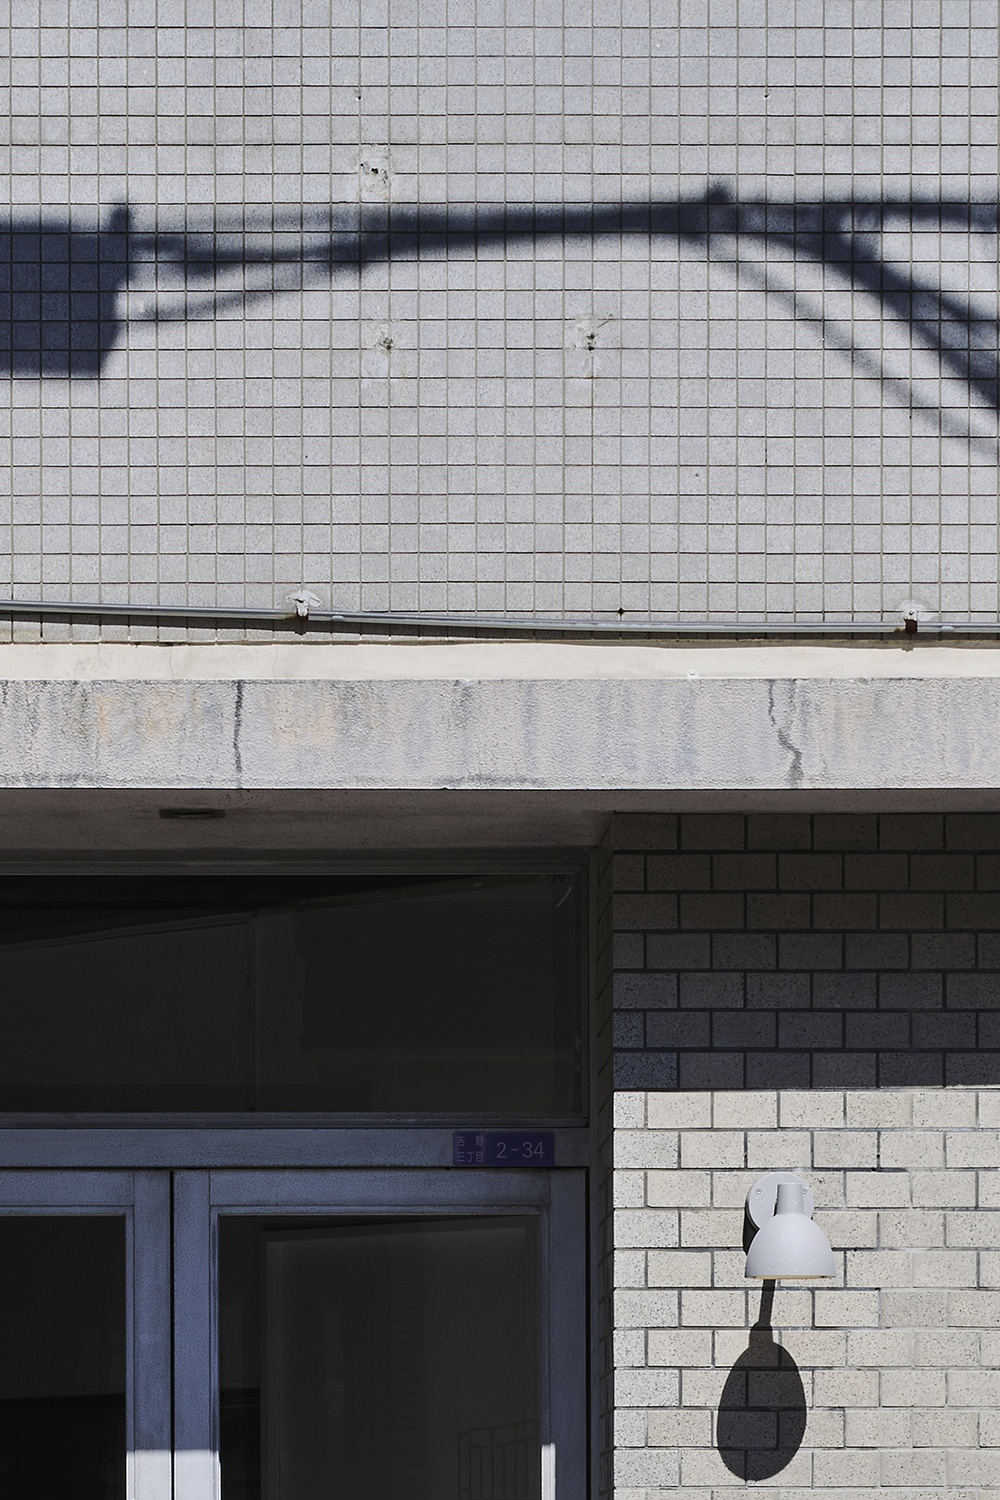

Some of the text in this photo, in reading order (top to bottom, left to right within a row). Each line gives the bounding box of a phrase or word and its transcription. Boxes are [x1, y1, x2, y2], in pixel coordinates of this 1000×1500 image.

[457, 1135, 484, 1147] 吉野
[496, 1141, 545, 1158] 2-34
[457, 1151, 484, 1162] 三丁目
